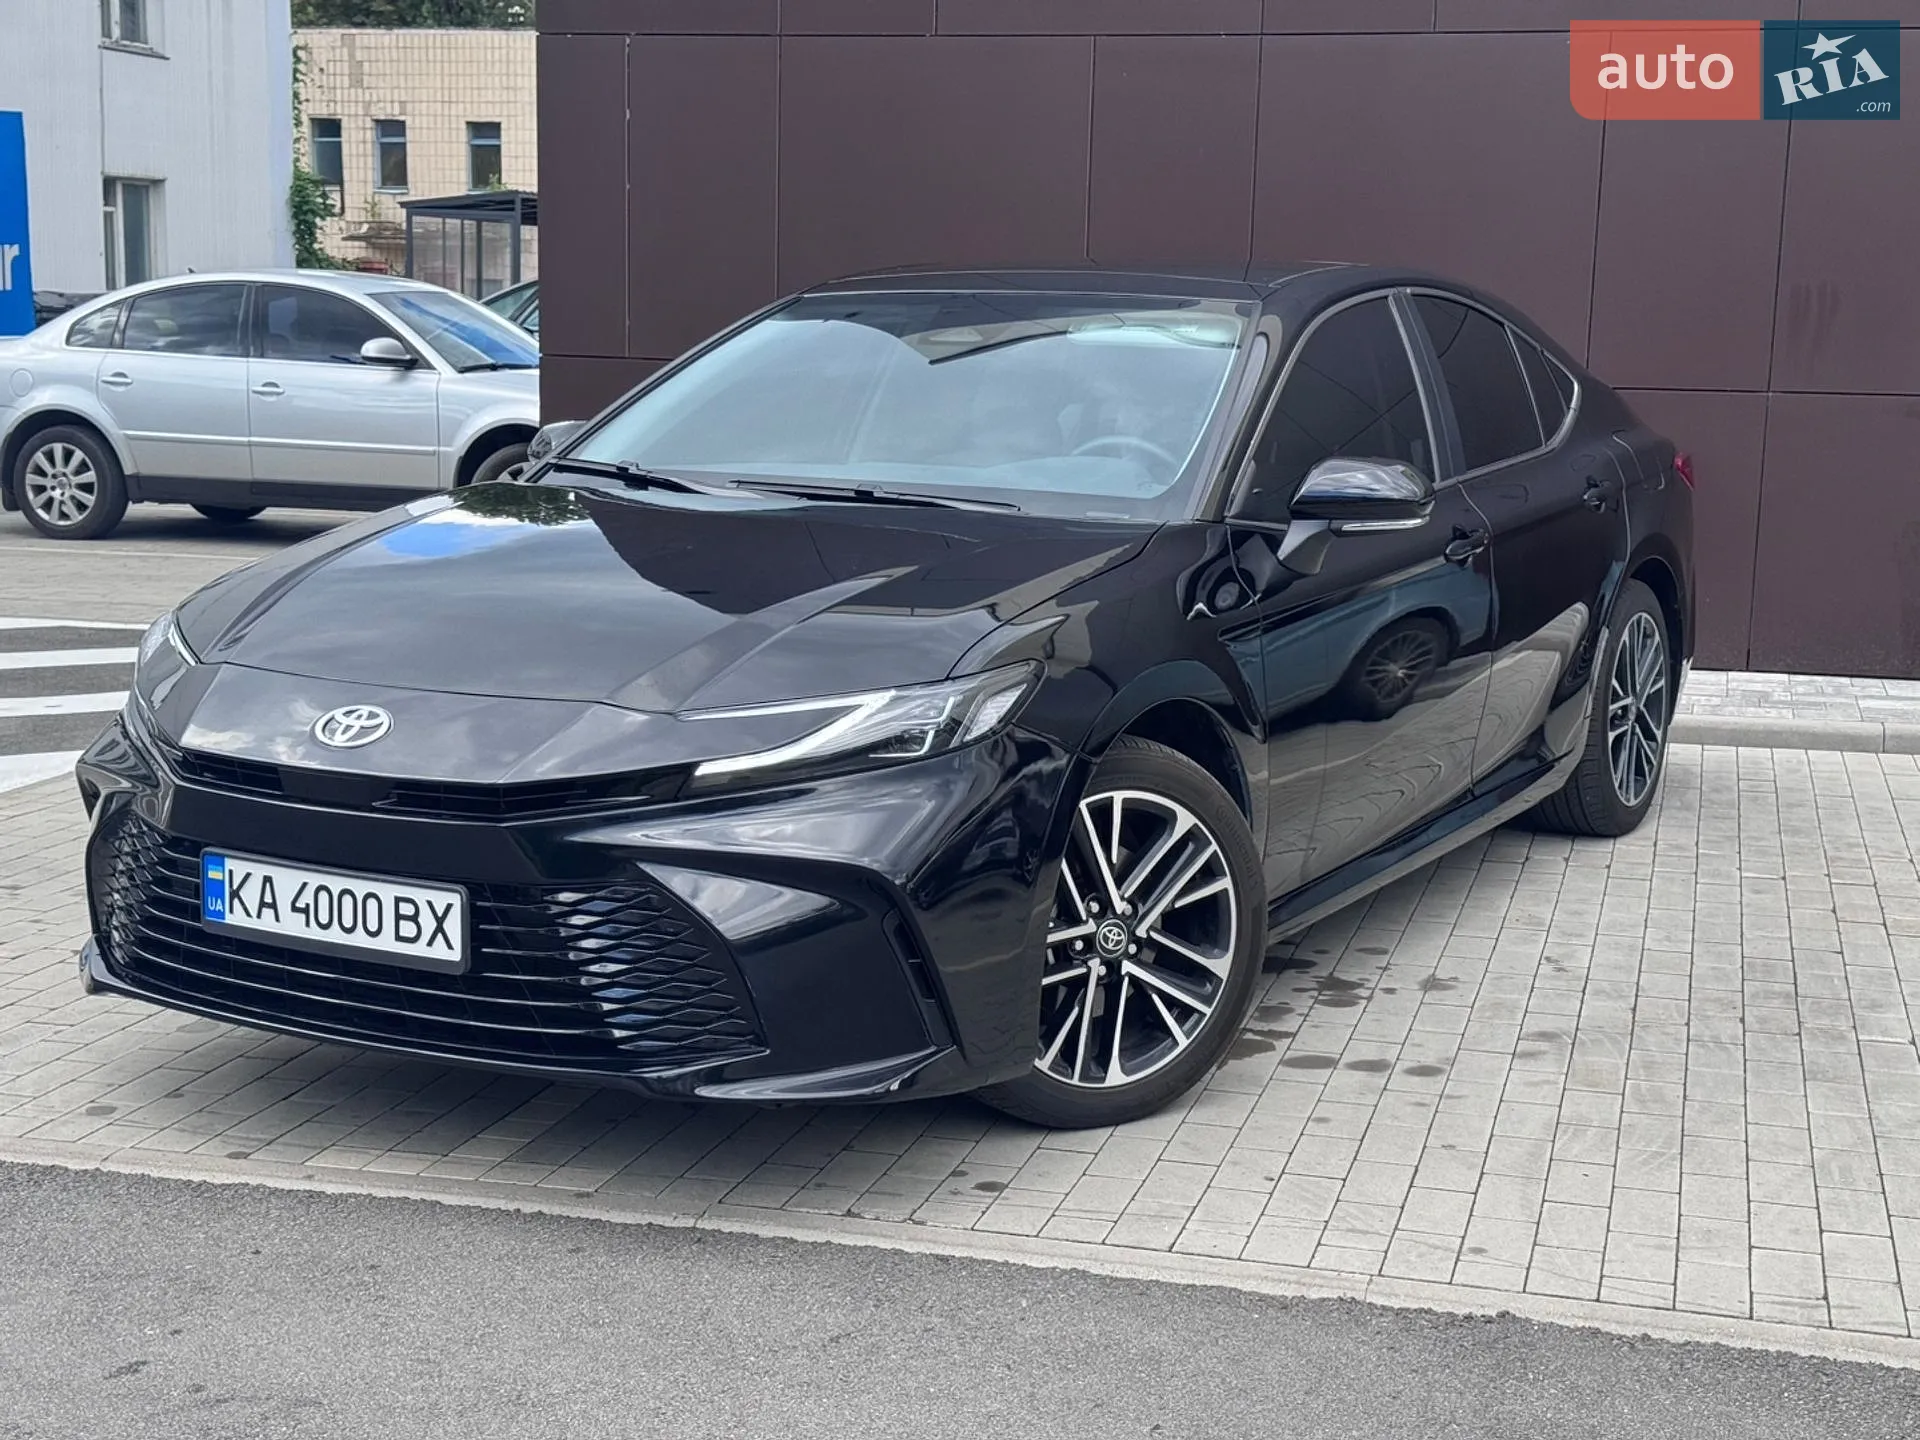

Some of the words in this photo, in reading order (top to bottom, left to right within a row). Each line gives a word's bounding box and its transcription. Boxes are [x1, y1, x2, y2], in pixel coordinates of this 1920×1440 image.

[0, 244, 20, 291] r
[208, 896, 224, 912] UA
[228, 869, 280, 923] KA
[290, 882, 383, 938] 4000
[393, 896, 455, 950] BX
